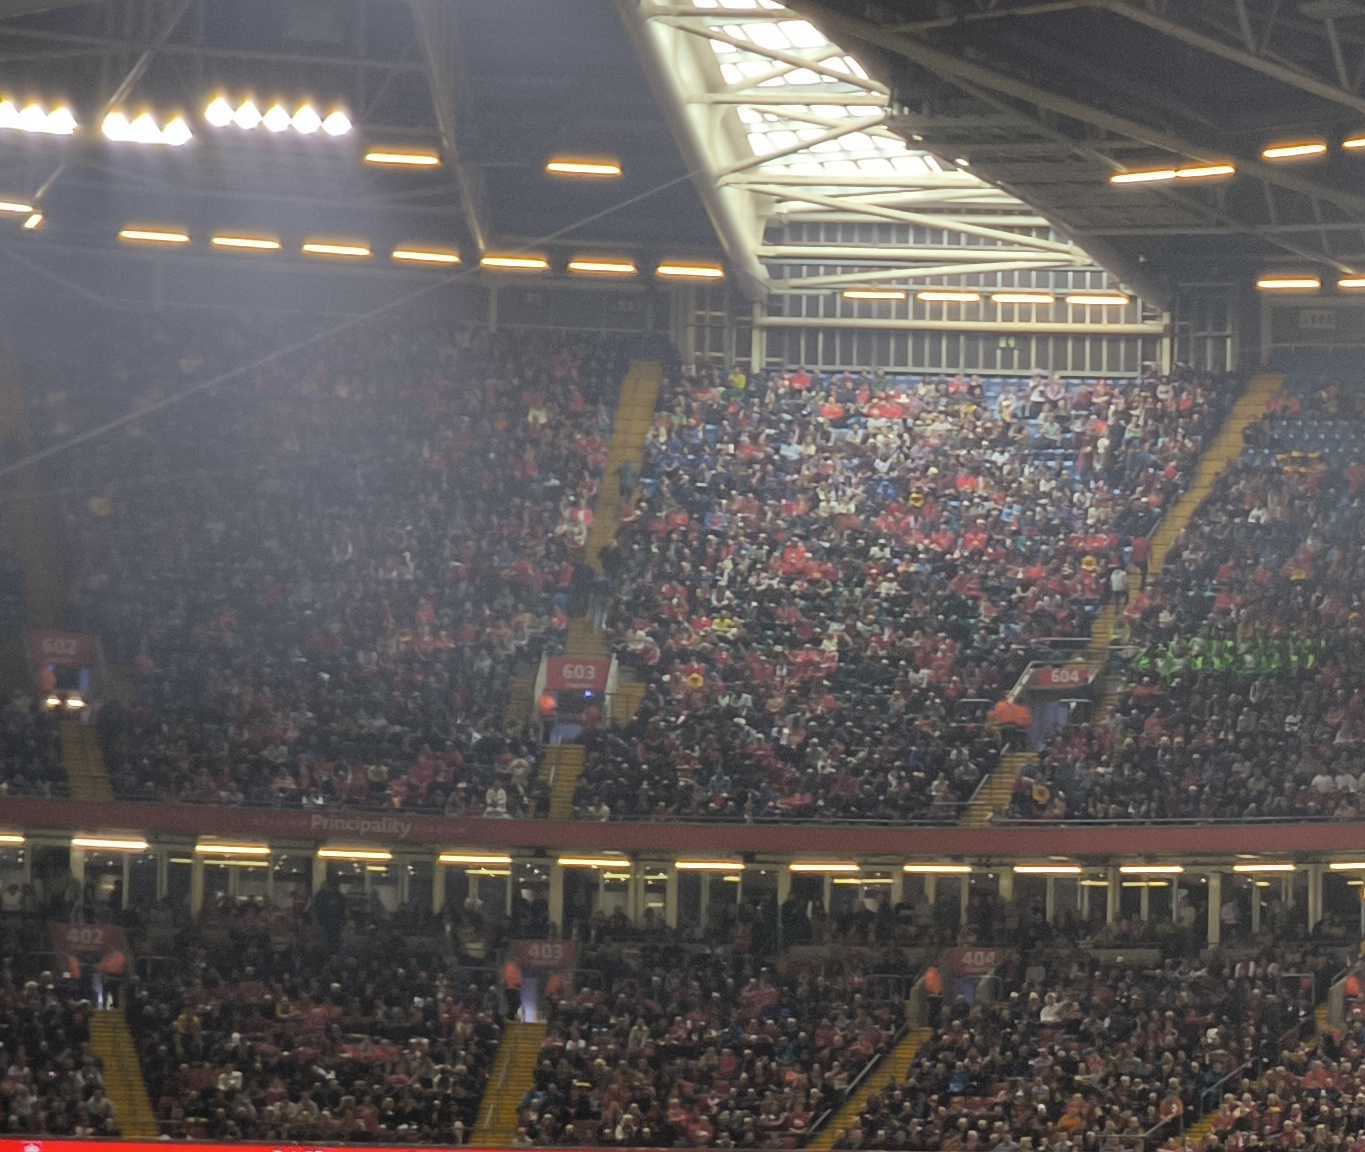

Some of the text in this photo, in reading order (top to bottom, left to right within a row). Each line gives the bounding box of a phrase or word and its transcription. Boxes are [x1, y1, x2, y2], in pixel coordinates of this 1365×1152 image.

[562, 664, 596, 680] 603
[1051, 669, 1079, 683] 604
[310, 814, 412, 838] Principality
[66, 927, 103, 944] 402
[528, 943, 563, 959] 403
[961, 951, 995, 965] 404
